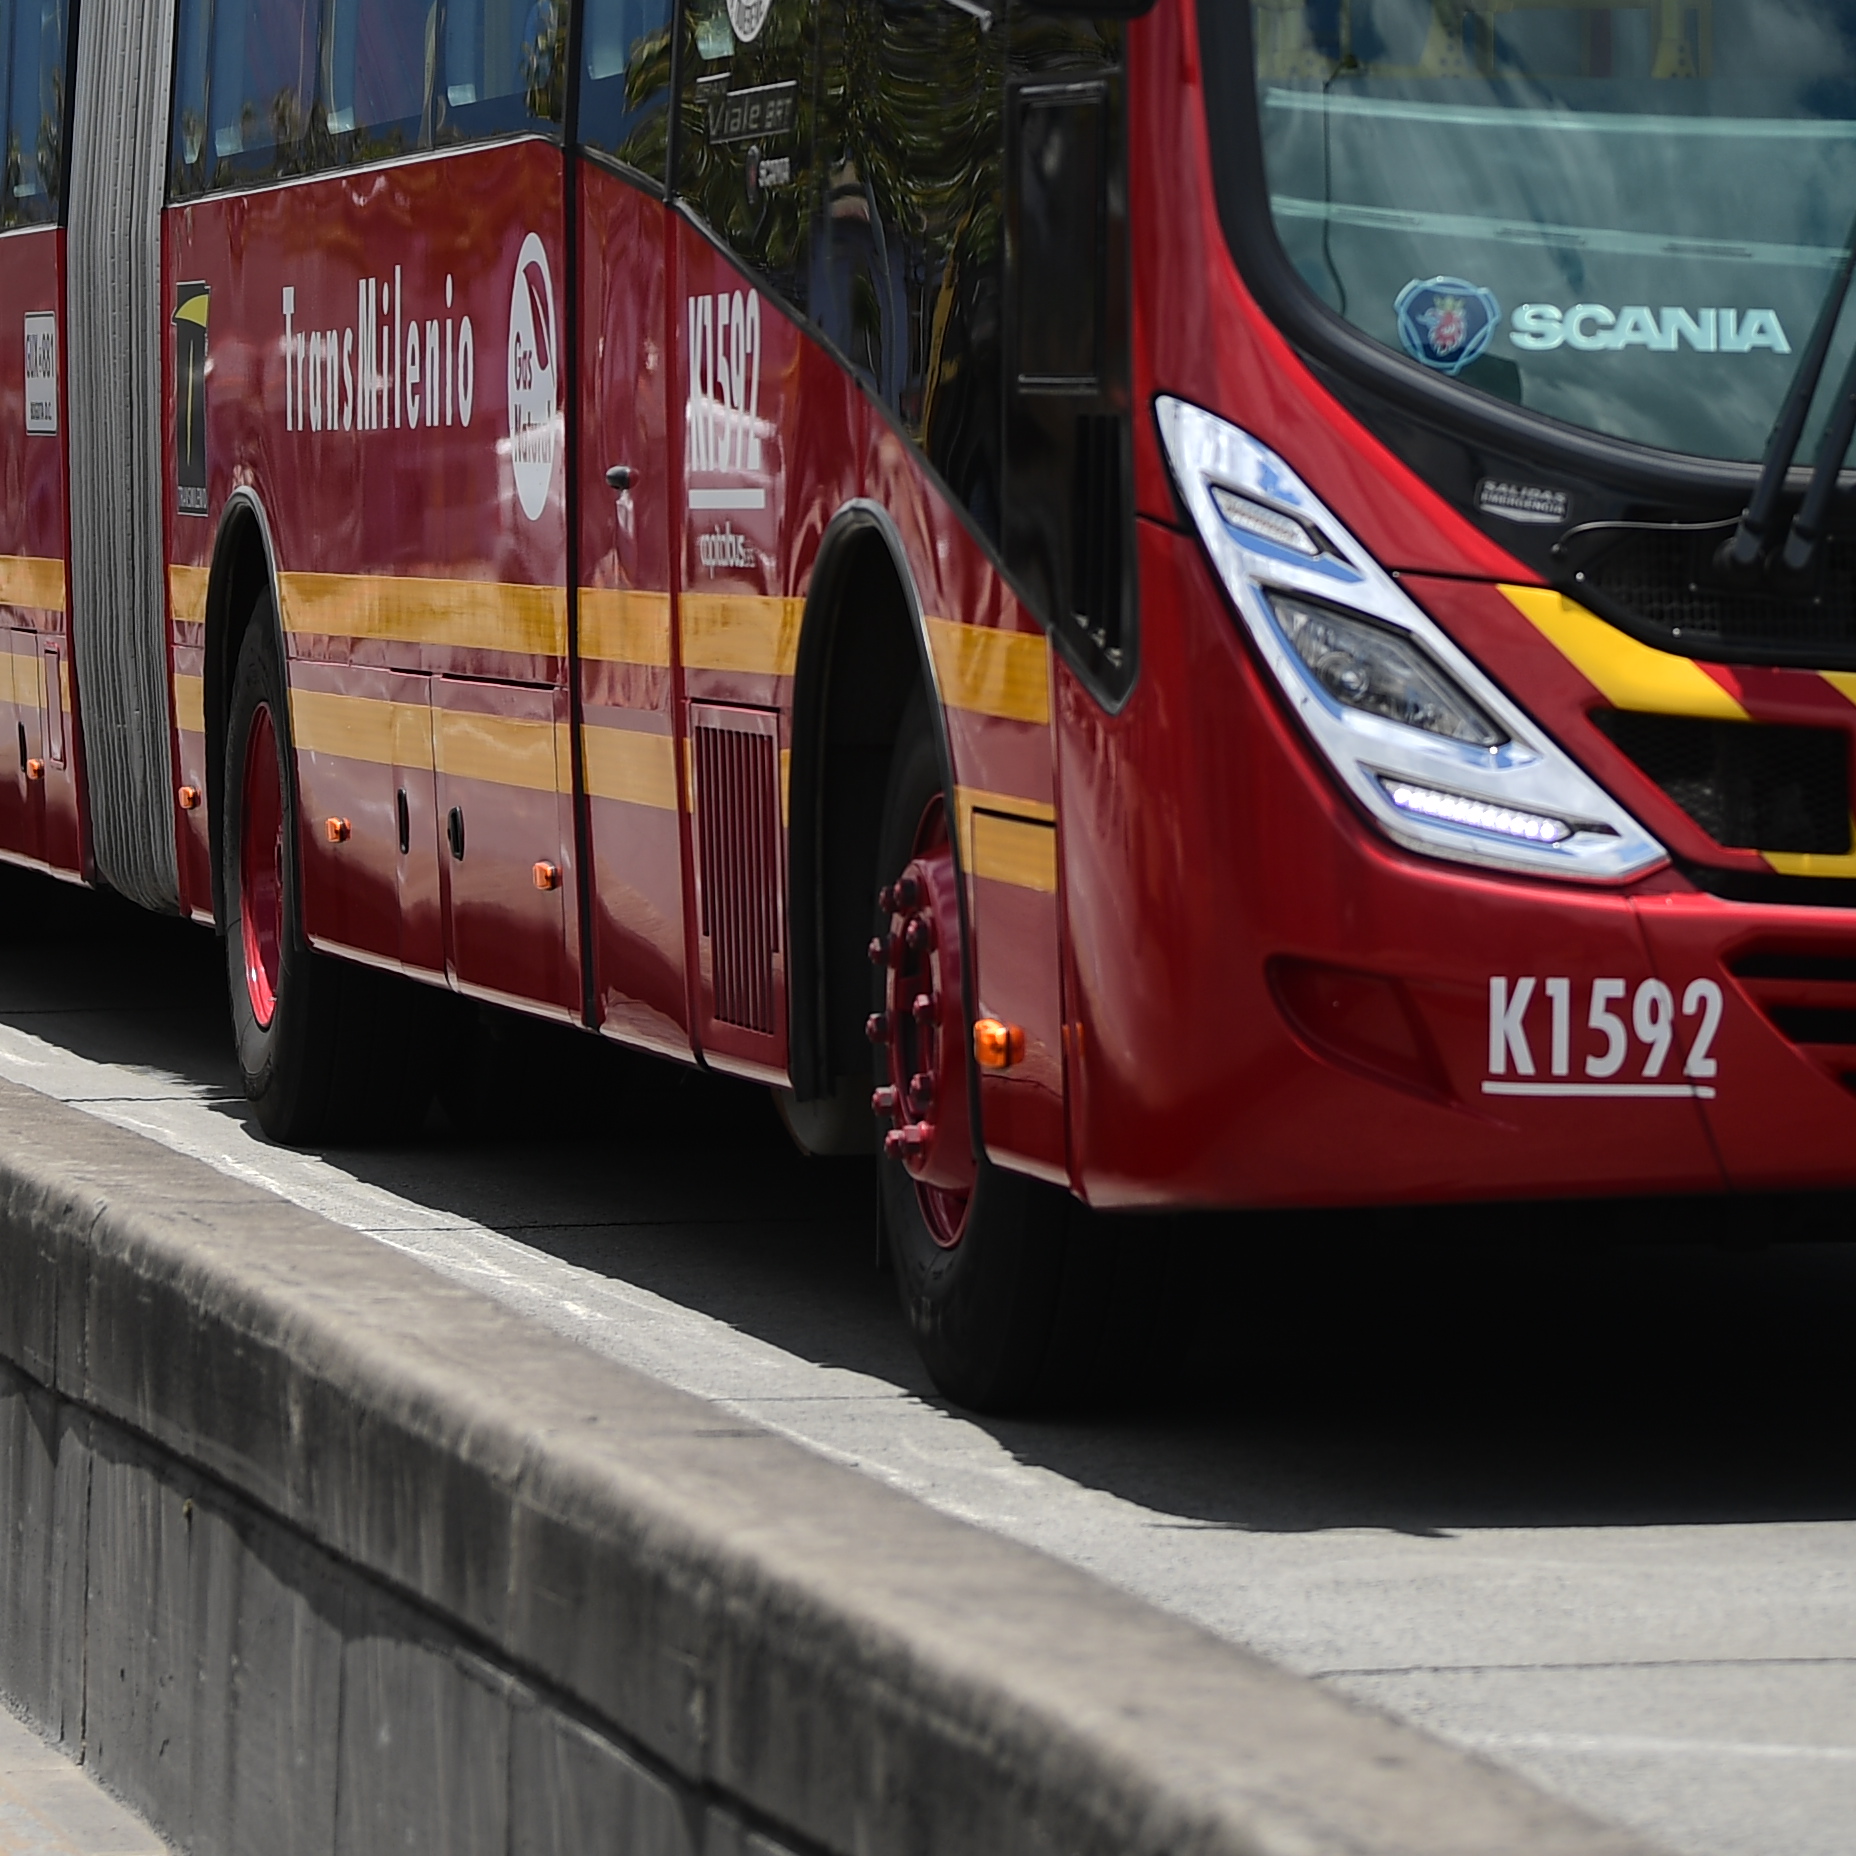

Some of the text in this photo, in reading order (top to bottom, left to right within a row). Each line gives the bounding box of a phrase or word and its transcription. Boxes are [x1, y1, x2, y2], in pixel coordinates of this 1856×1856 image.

[708, 95, 761, 136] Viale
[282, 264, 474, 433] TransMilenio
[514, 330, 533, 391] Gas
[1508, 302, 1793, 354] SCANIA
[688, 288, 761, 473] K1592
[513, 399, 552, 464] Natural
[1488, 975, 1724, 1079] K1592
